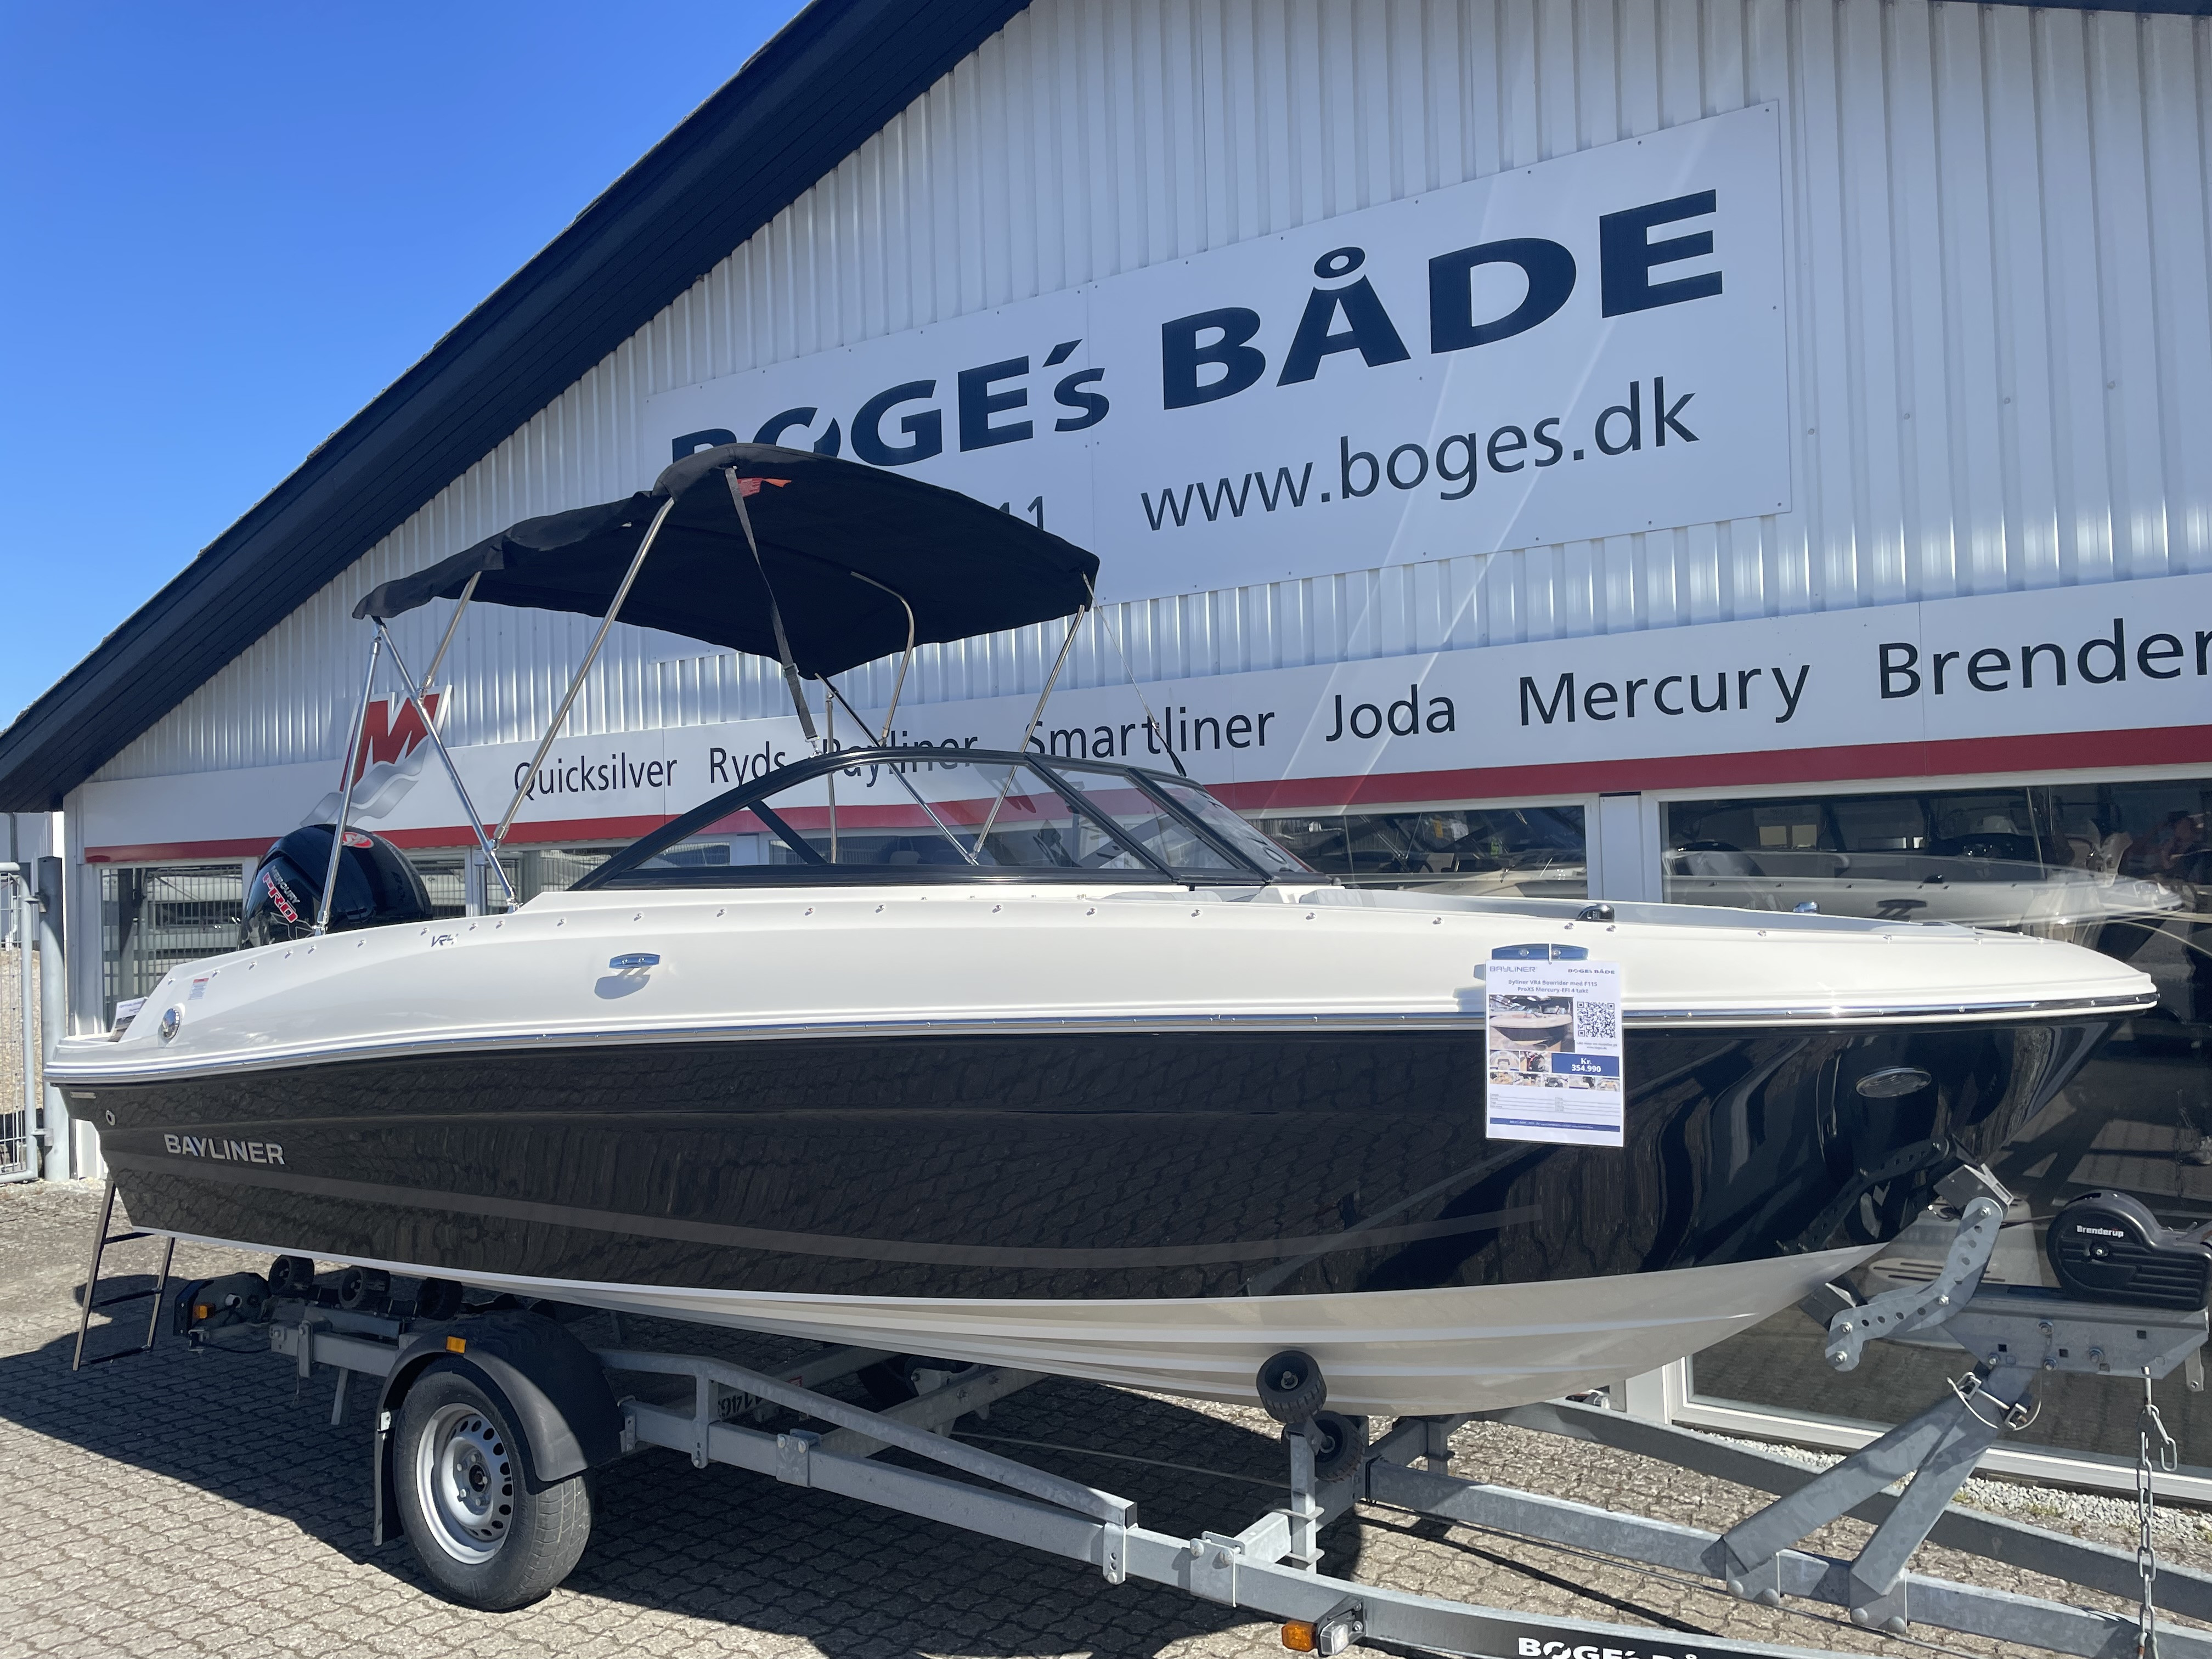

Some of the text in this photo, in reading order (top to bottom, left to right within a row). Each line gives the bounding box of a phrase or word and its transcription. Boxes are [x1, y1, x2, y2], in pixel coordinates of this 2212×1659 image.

[1162, 189, 1723, 410] BÅDE
[1141, 376, 1700, 531] www.boges.dk
[515, 752, 678, 800] Quicksilver
[710, 741, 786, 787] Ryds
[1325, 684, 1455, 742] Joda
[1519, 664, 1810, 726] Mercury
[262, 872, 298, 923] PRO
[271, 865, 301, 904] MERCURY
[1571, 1064, 1601, 1073] 354.990
[164, 1133, 285, 1165] BAYLINER
[2076, 1224, 2124, 1238] Brenderup
